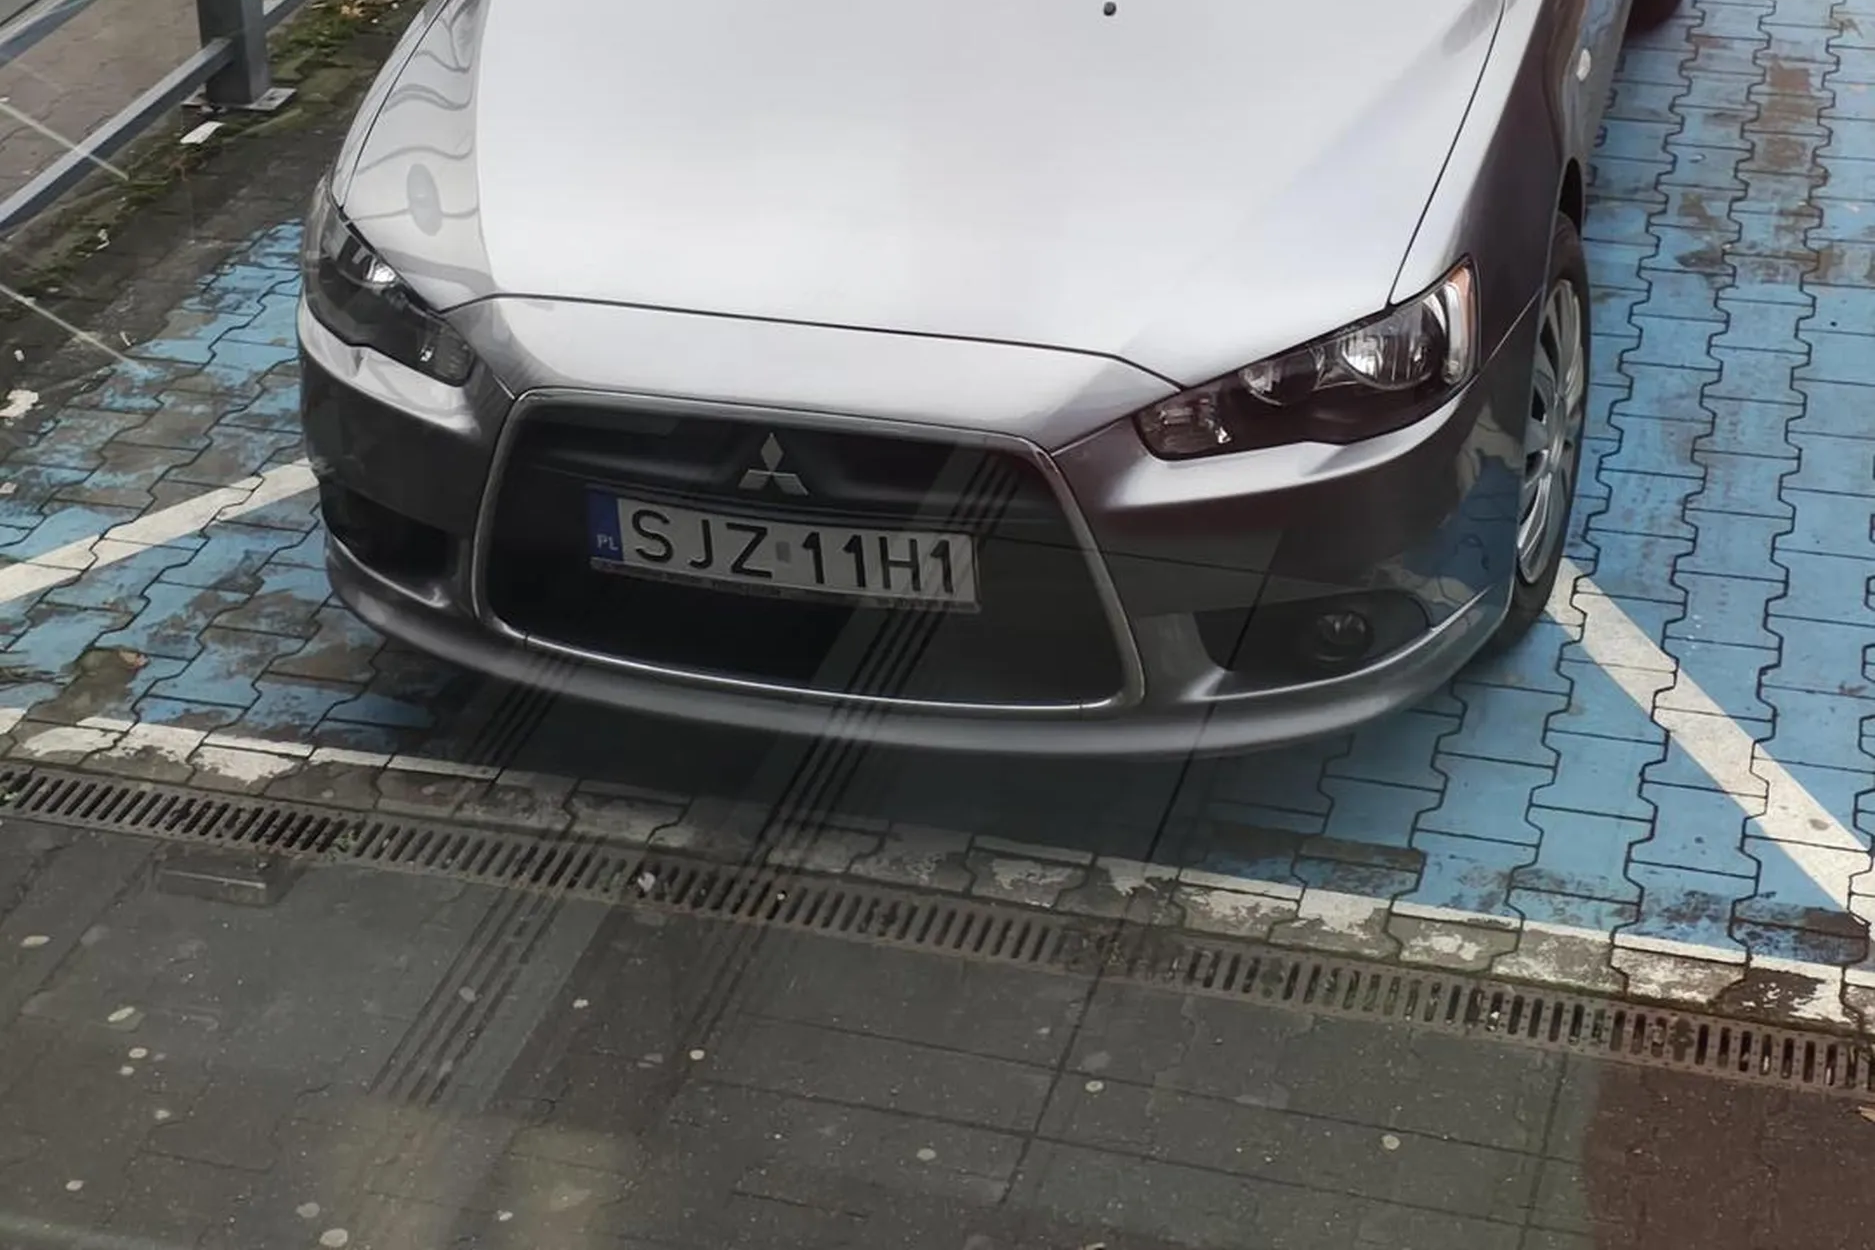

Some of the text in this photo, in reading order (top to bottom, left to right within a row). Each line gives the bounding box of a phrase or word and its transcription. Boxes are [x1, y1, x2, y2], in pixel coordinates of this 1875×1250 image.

[596, 509, 954, 595] PL SJZ 11H1
